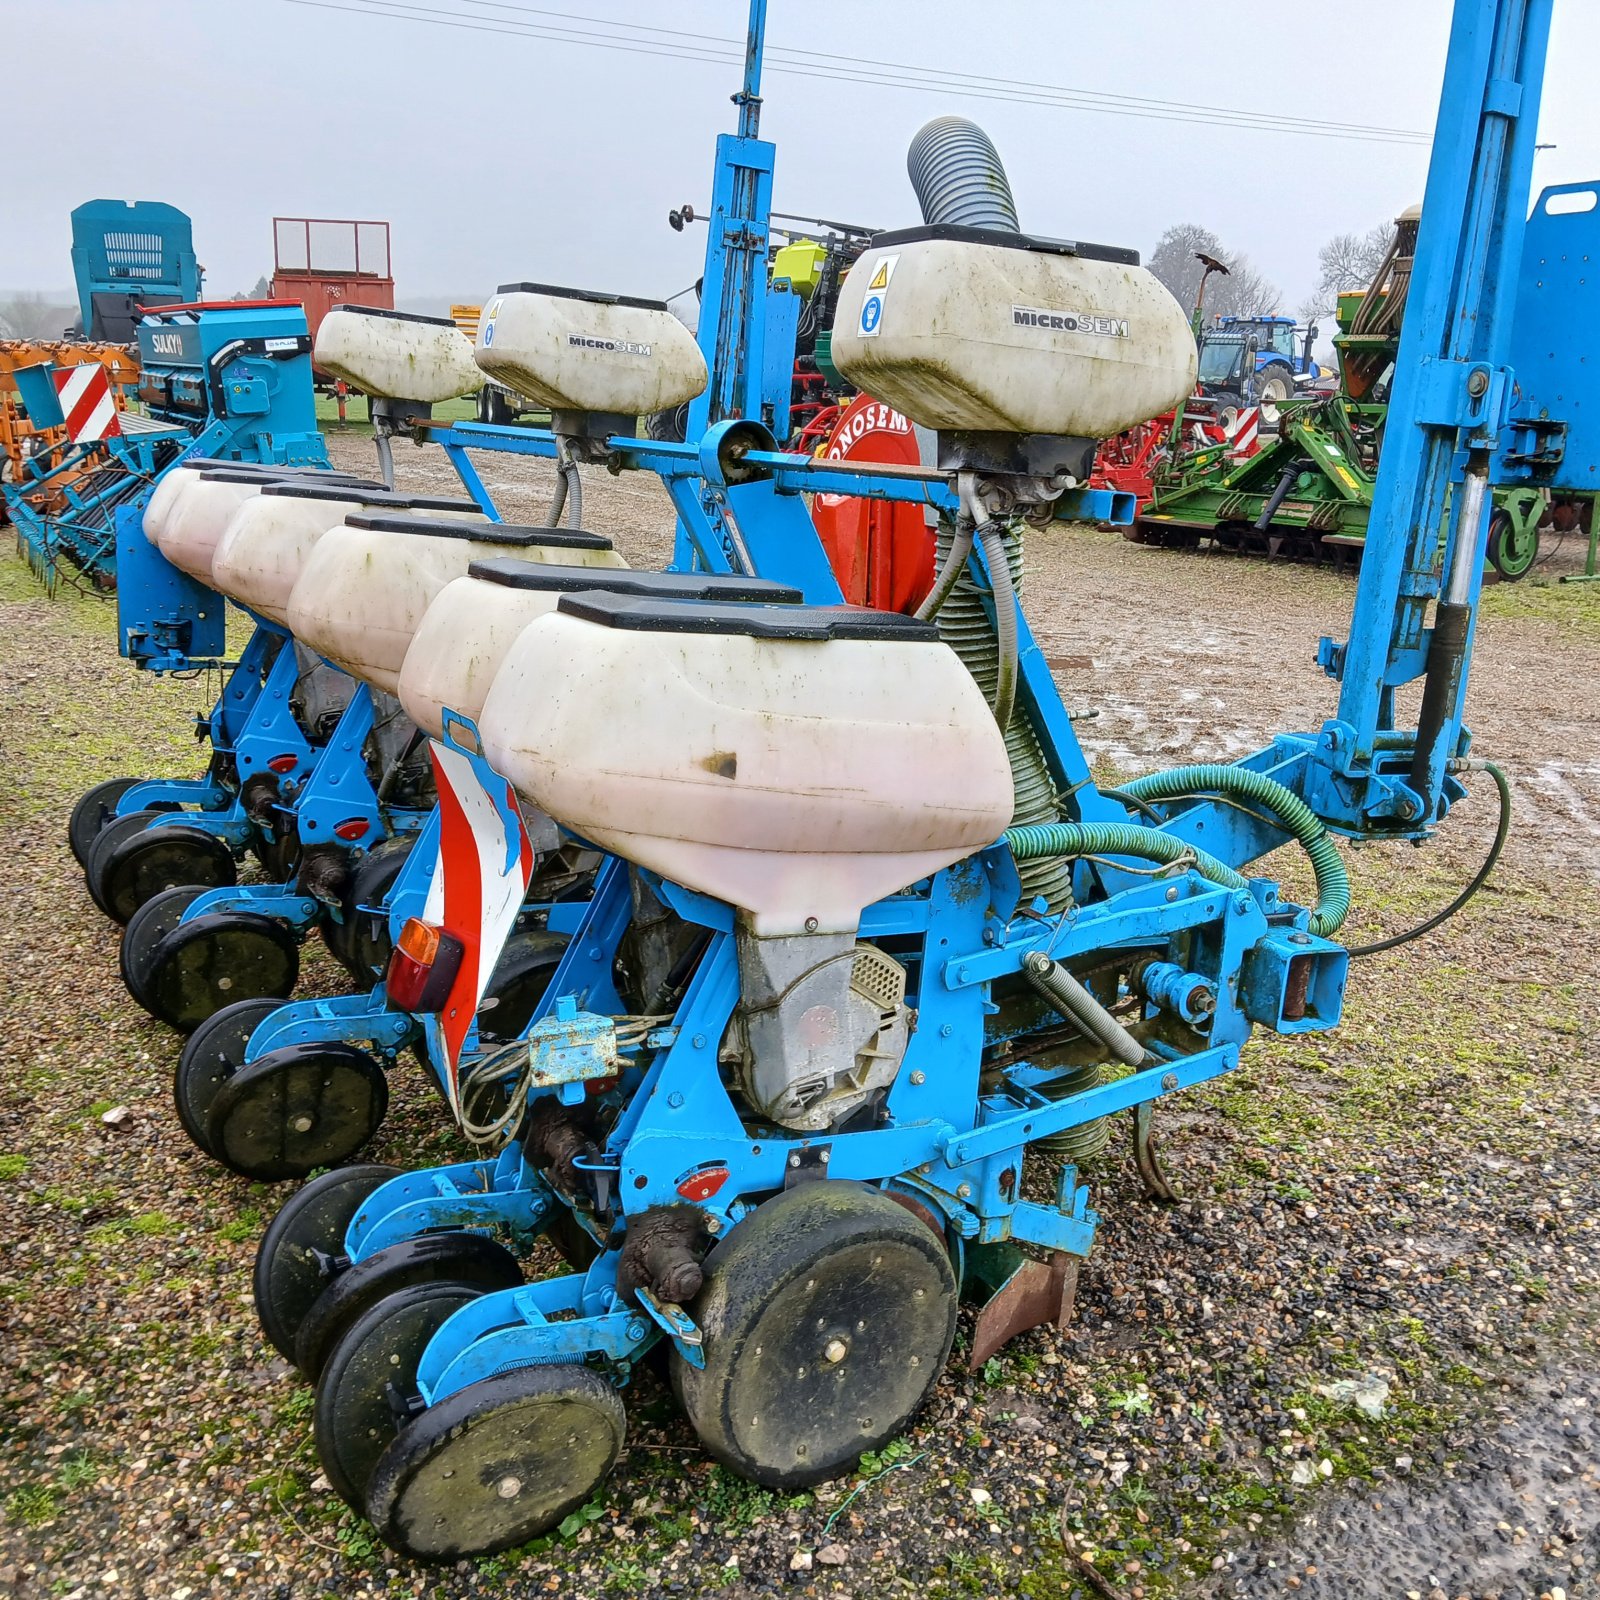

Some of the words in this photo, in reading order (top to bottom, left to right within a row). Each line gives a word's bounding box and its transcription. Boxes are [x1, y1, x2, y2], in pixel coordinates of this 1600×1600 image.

[1013, 311, 1129, 338] MICROSEM
[152, 334, 177, 354] SULKY
[569, 337, 652, 357] MICROSEM
[829, 404, 908, 461] ONOSEM
